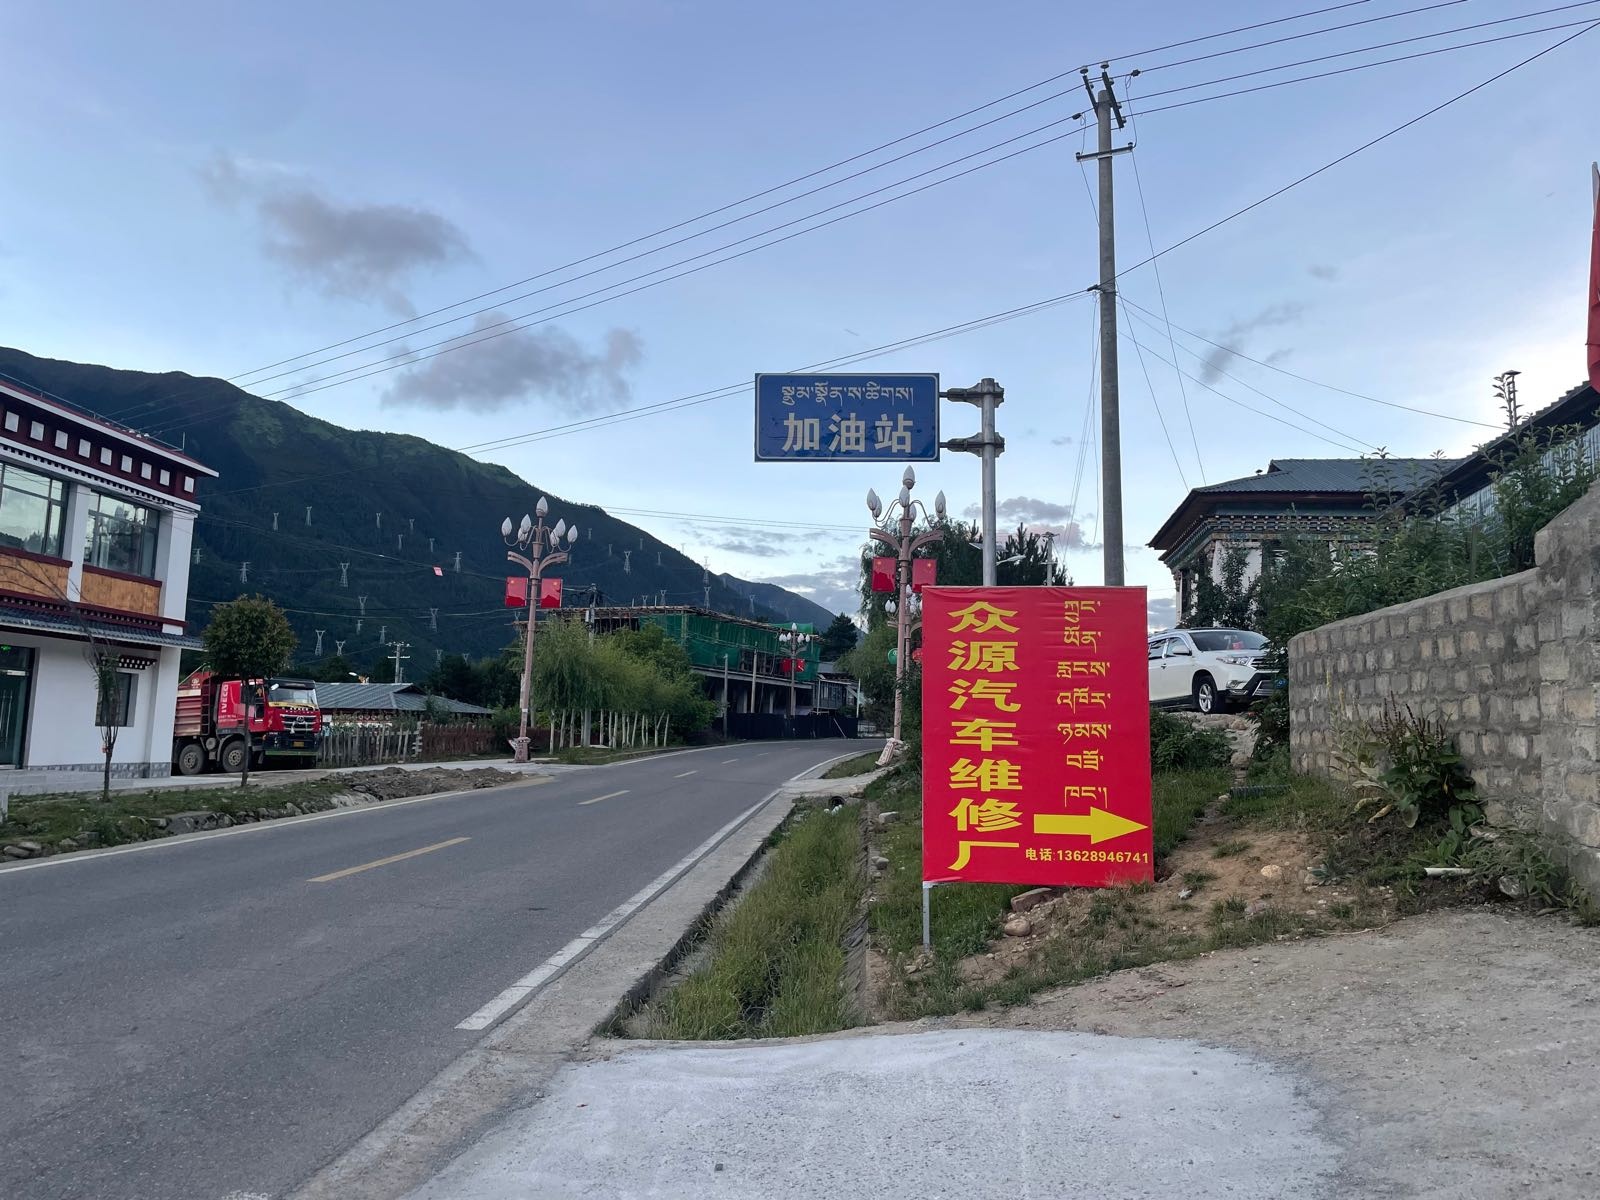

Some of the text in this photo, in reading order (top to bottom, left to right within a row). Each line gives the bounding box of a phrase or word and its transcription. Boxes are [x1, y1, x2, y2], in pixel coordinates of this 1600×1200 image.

[781, 412, 914, 453] 加油站
[221, 684, 229, 713] IVECO
[947, 601, 1024, 871] 众源汽车维修厂
